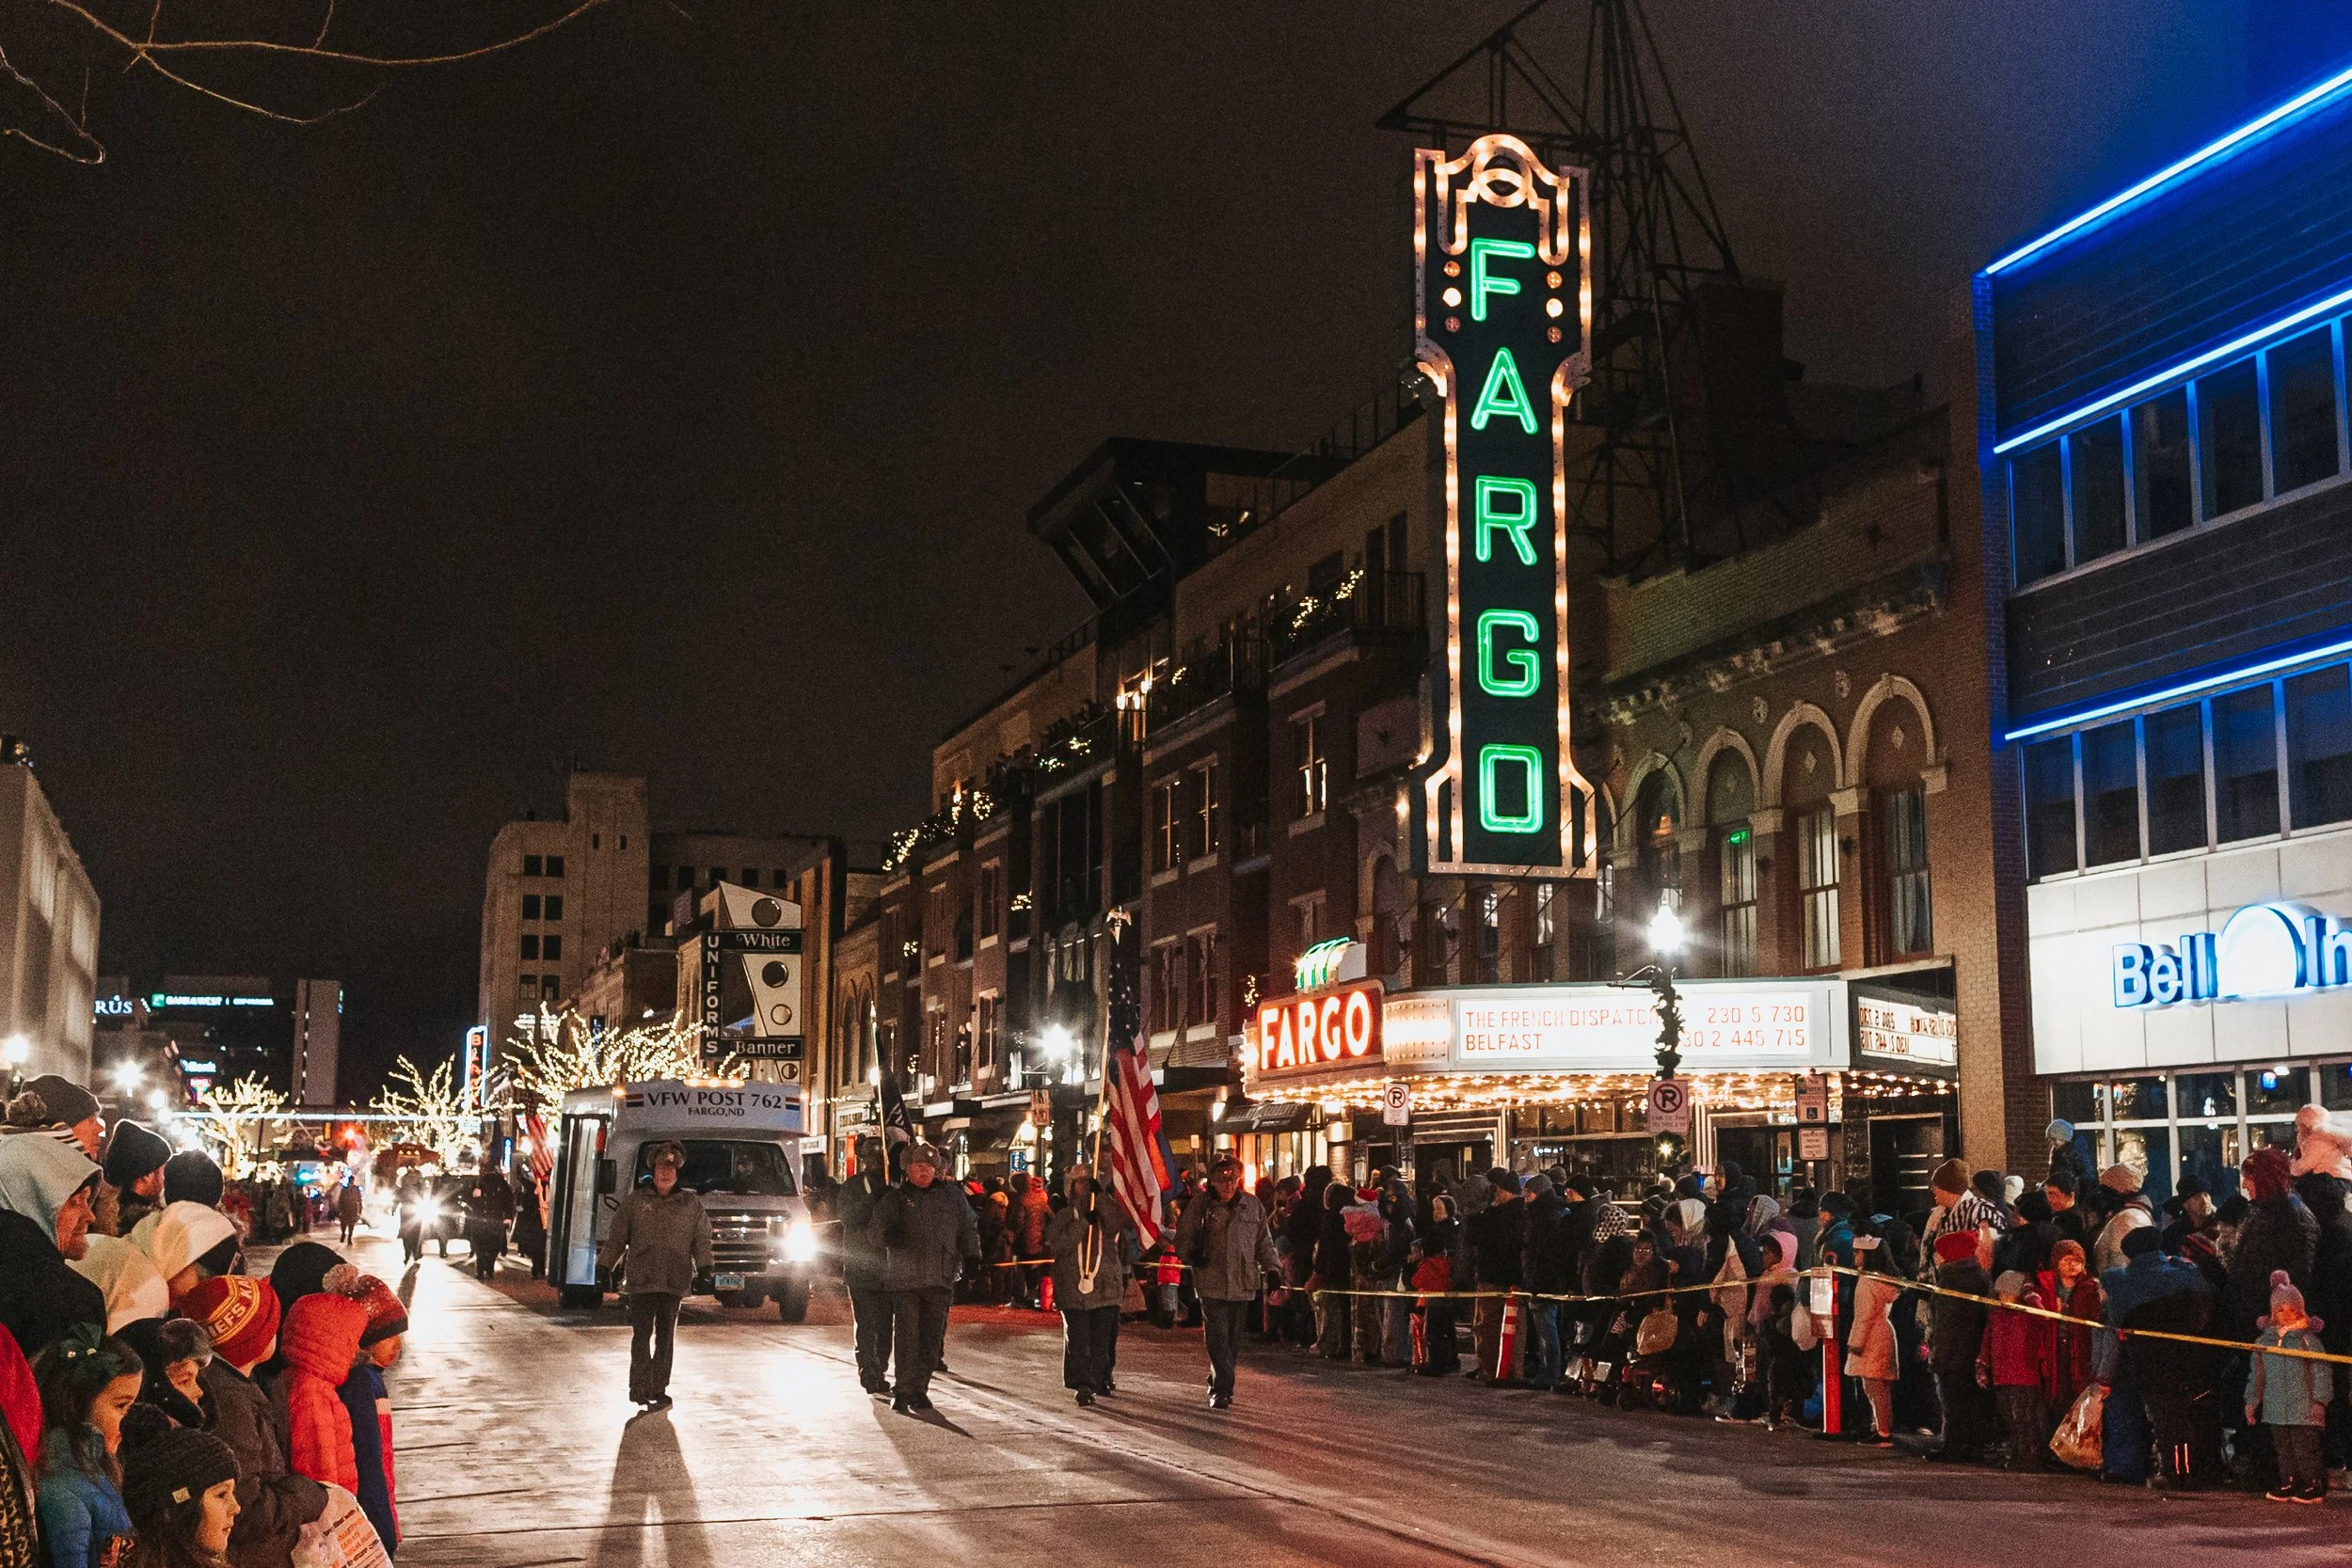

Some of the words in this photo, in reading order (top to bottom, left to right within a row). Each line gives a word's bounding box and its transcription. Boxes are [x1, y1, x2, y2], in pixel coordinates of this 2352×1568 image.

[1470, 237, 1543, 834] FARGO
[736, 932, 791, 950] White
[2112, 932, 2218, 1008] Bell
[706, 935, 721, 1054] UNIFORMS
[1261, 990, 1371, 1070] FARGO
[1465, 1011, 1495, 1028] THE
[1501, 1009, 1564, 1028] FRENCH
[1708, 1006, 1741, 1024] 230
[1751, 1006, 1761, 1023] 5
[1770, 1006, 1804, 1022] 730
[735, 1040, 796, 1056] Banner
[1466, 1033, 1542, 1051] BELFAST
[1712, 1030, 1721, 1047] 2
[1731, 1029, 1765, 1047] 445
[1774, 1028, 1805, 1046] 715
[647, 1091, 691, 1106] VFW
[697, 1091, 745, 1106] POST
[751, 1093, 783, 1109] 762
[208, 1302, 246, 1337] IEFS
